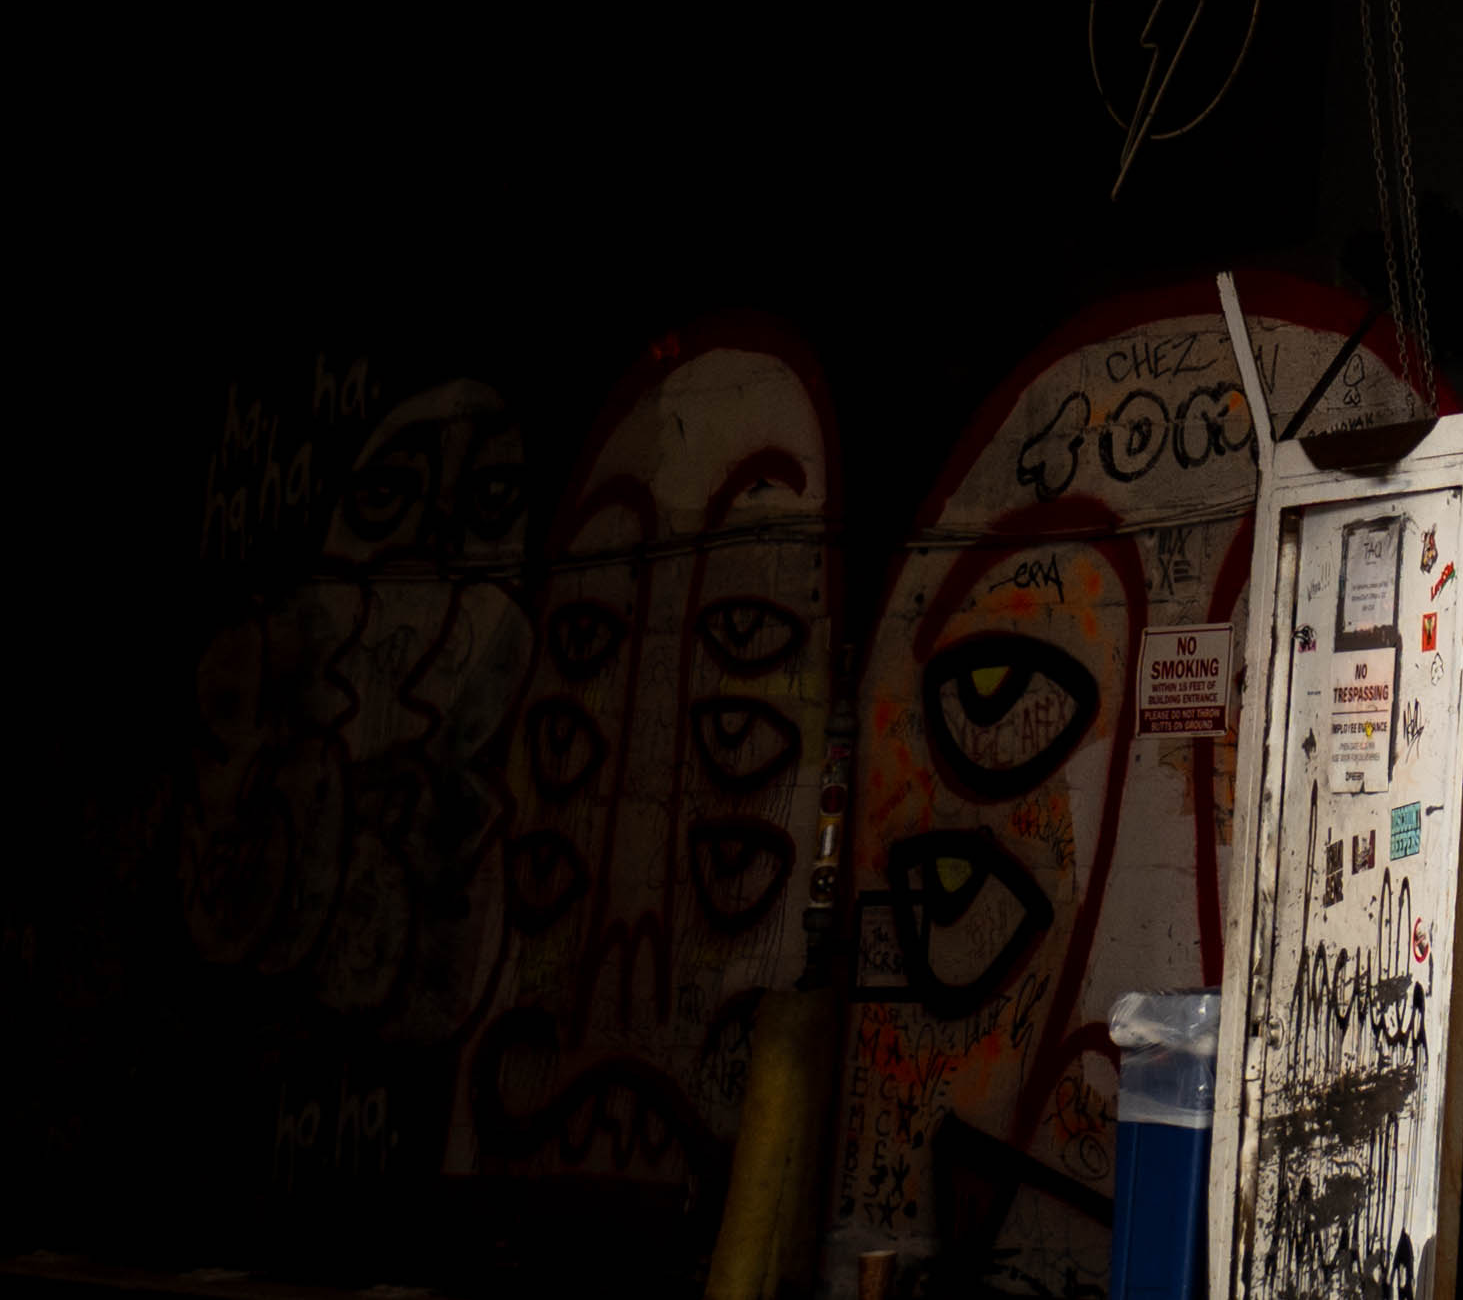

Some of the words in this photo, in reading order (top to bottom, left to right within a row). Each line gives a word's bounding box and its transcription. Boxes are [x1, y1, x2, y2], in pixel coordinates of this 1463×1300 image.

[1177, 636, 1197, 656] NO
[1151, 658, 1219, 680] SMOKING
[1355, 663, 1368, 680] NO
[1152, 682, 1177, 692] WITHIN
[1189, 681, 1205, 691] FEET
[1207, 680, 1216, 690] OF
[1148, 694, 1181, 704] BUILDING
[1183, 693, 1218, 704] ENTRANCE
[1333, 685, 1389, 704] TRESPASSING
[1144, 710, 1169, 720] PLEASE
[1171, 710, 1181, 720] DO
[1182, 709, 1195, 719] NOT
[1196, 709, 1221, 718] THROW
[1151, 721, 1172, 731] BUTTS
[1173, 721, 1183, 730] ON
[1184, 720, 1213, 730] GROUND
[1358, 722, 1388, 734] ENANCE
